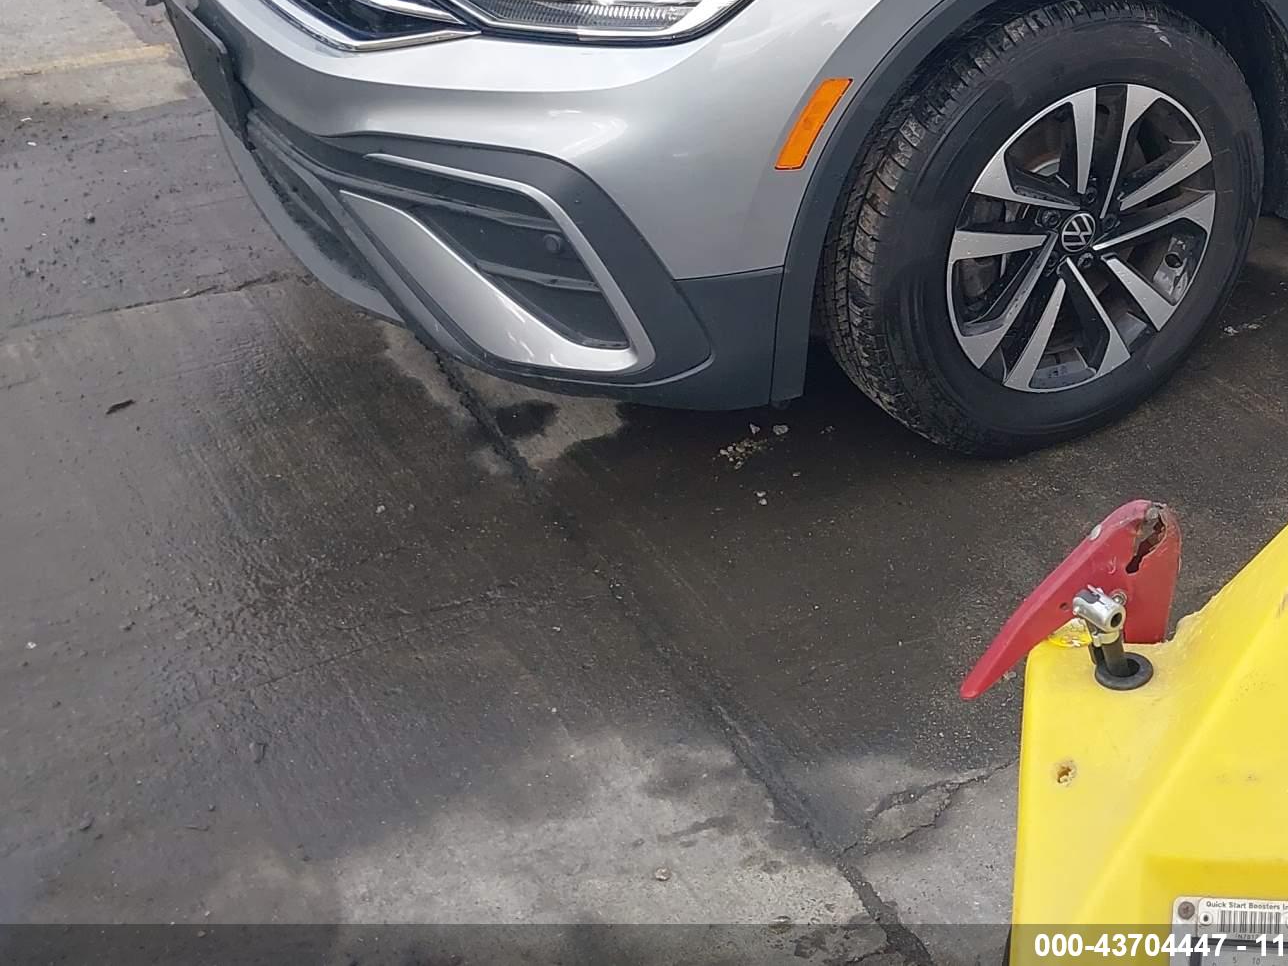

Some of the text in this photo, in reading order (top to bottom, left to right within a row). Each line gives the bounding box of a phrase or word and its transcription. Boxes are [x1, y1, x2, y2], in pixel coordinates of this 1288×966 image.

[1206, 900, 1227, 908] Quick
[1229, 901, 1247, 909] Start
[1248, 902, 1281, 910] Boosters
